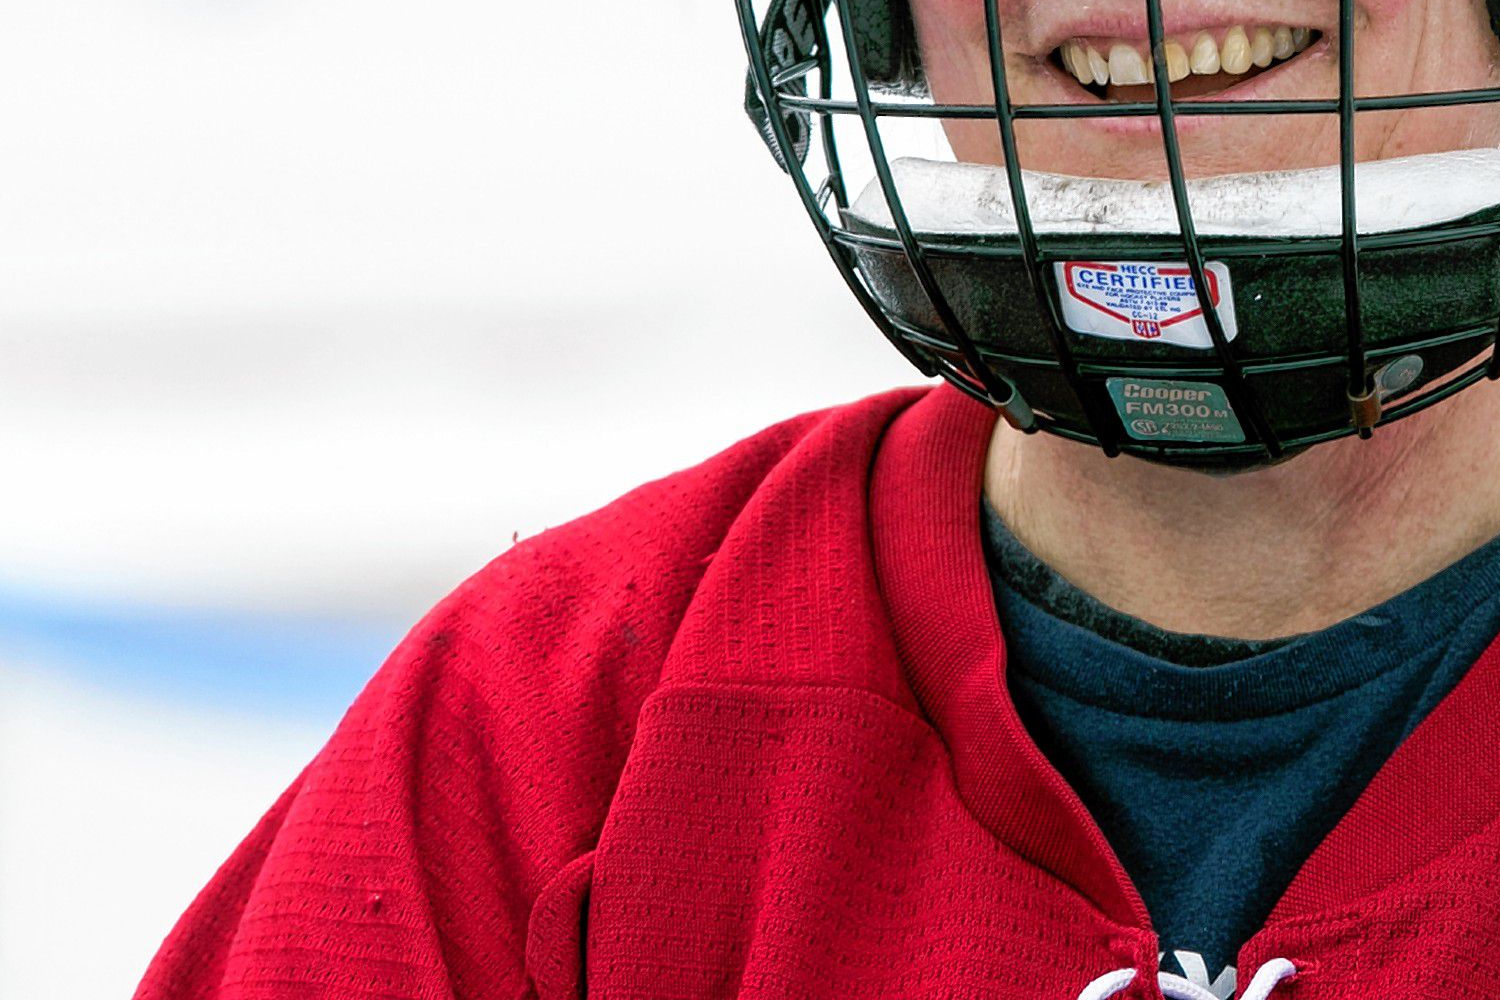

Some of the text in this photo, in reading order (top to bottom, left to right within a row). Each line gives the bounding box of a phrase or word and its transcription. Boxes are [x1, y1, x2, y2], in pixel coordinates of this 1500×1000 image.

[1121, 264, 1156, 275] HECC
[1124, 383, 1212, 402] Cooper
[1126, 401, 1212, 418] FM300
